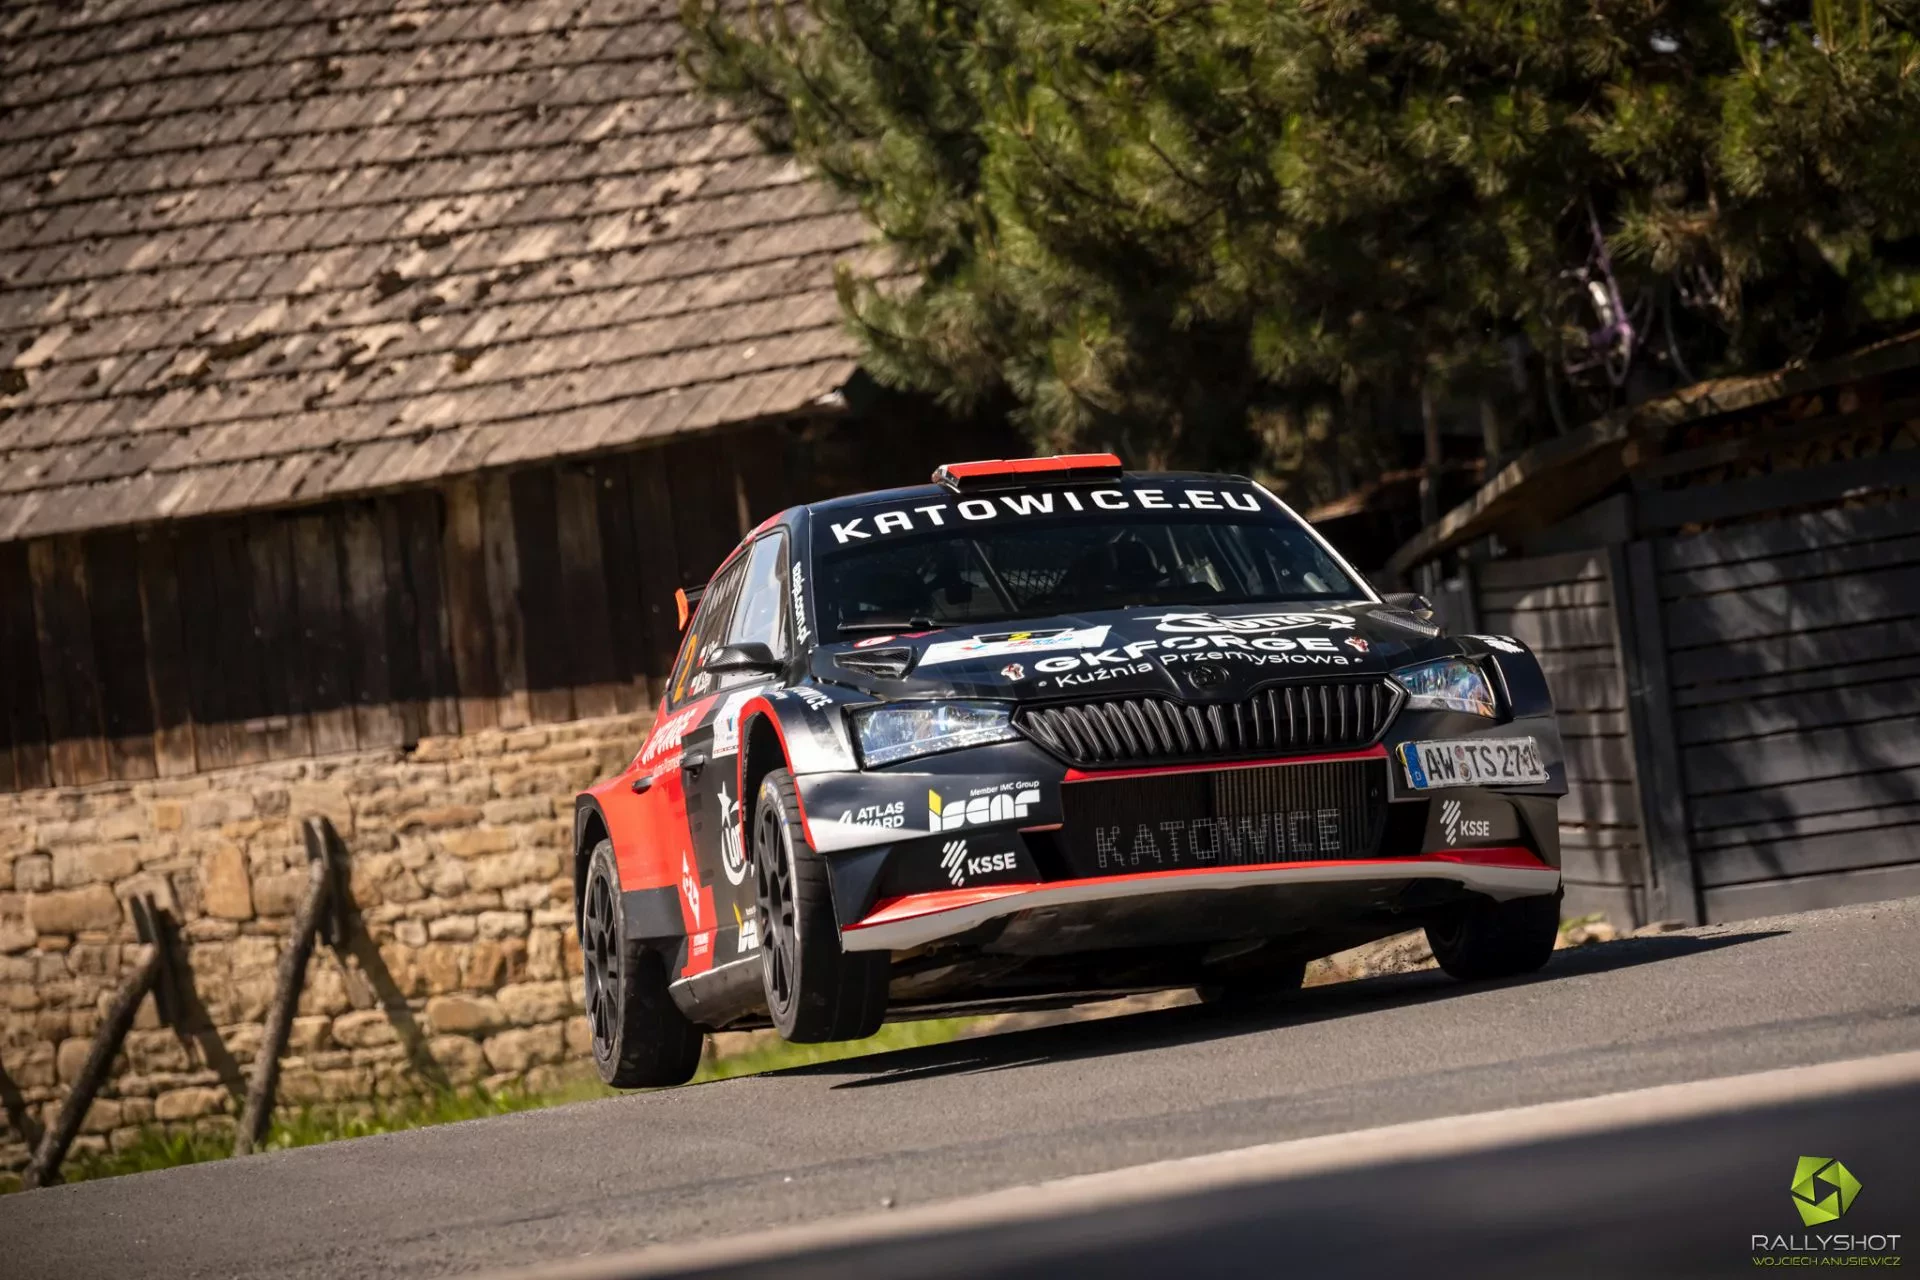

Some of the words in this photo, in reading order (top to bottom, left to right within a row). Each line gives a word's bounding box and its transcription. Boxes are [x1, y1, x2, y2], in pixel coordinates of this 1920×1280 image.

[831, 489, 1262, 544] KATOWICE.EU
[1034, 634, 1340, 672] GKFORGE
[673, 634, 697, 703] 2
[1055, 660, 1153, 688] Kuźnia
[1425, 746, 1456, 781] AW
[1464, 745, 1497, 778] TS
[1497, 745, 1541, 777] 271
[970, 786, 998, 797] Member
[1000, 782, 1014, 791] IMC
[1016, 780, 1040, 790] Group
[856, 801, 904, 820] ATLAS
[857, 814, 904, 830] WARD
[1095, 808, 1341, 868] KATOWICE
[1460, 820, 1490, 836] KSSE
[968, 852, 1017, 876] KSSE
